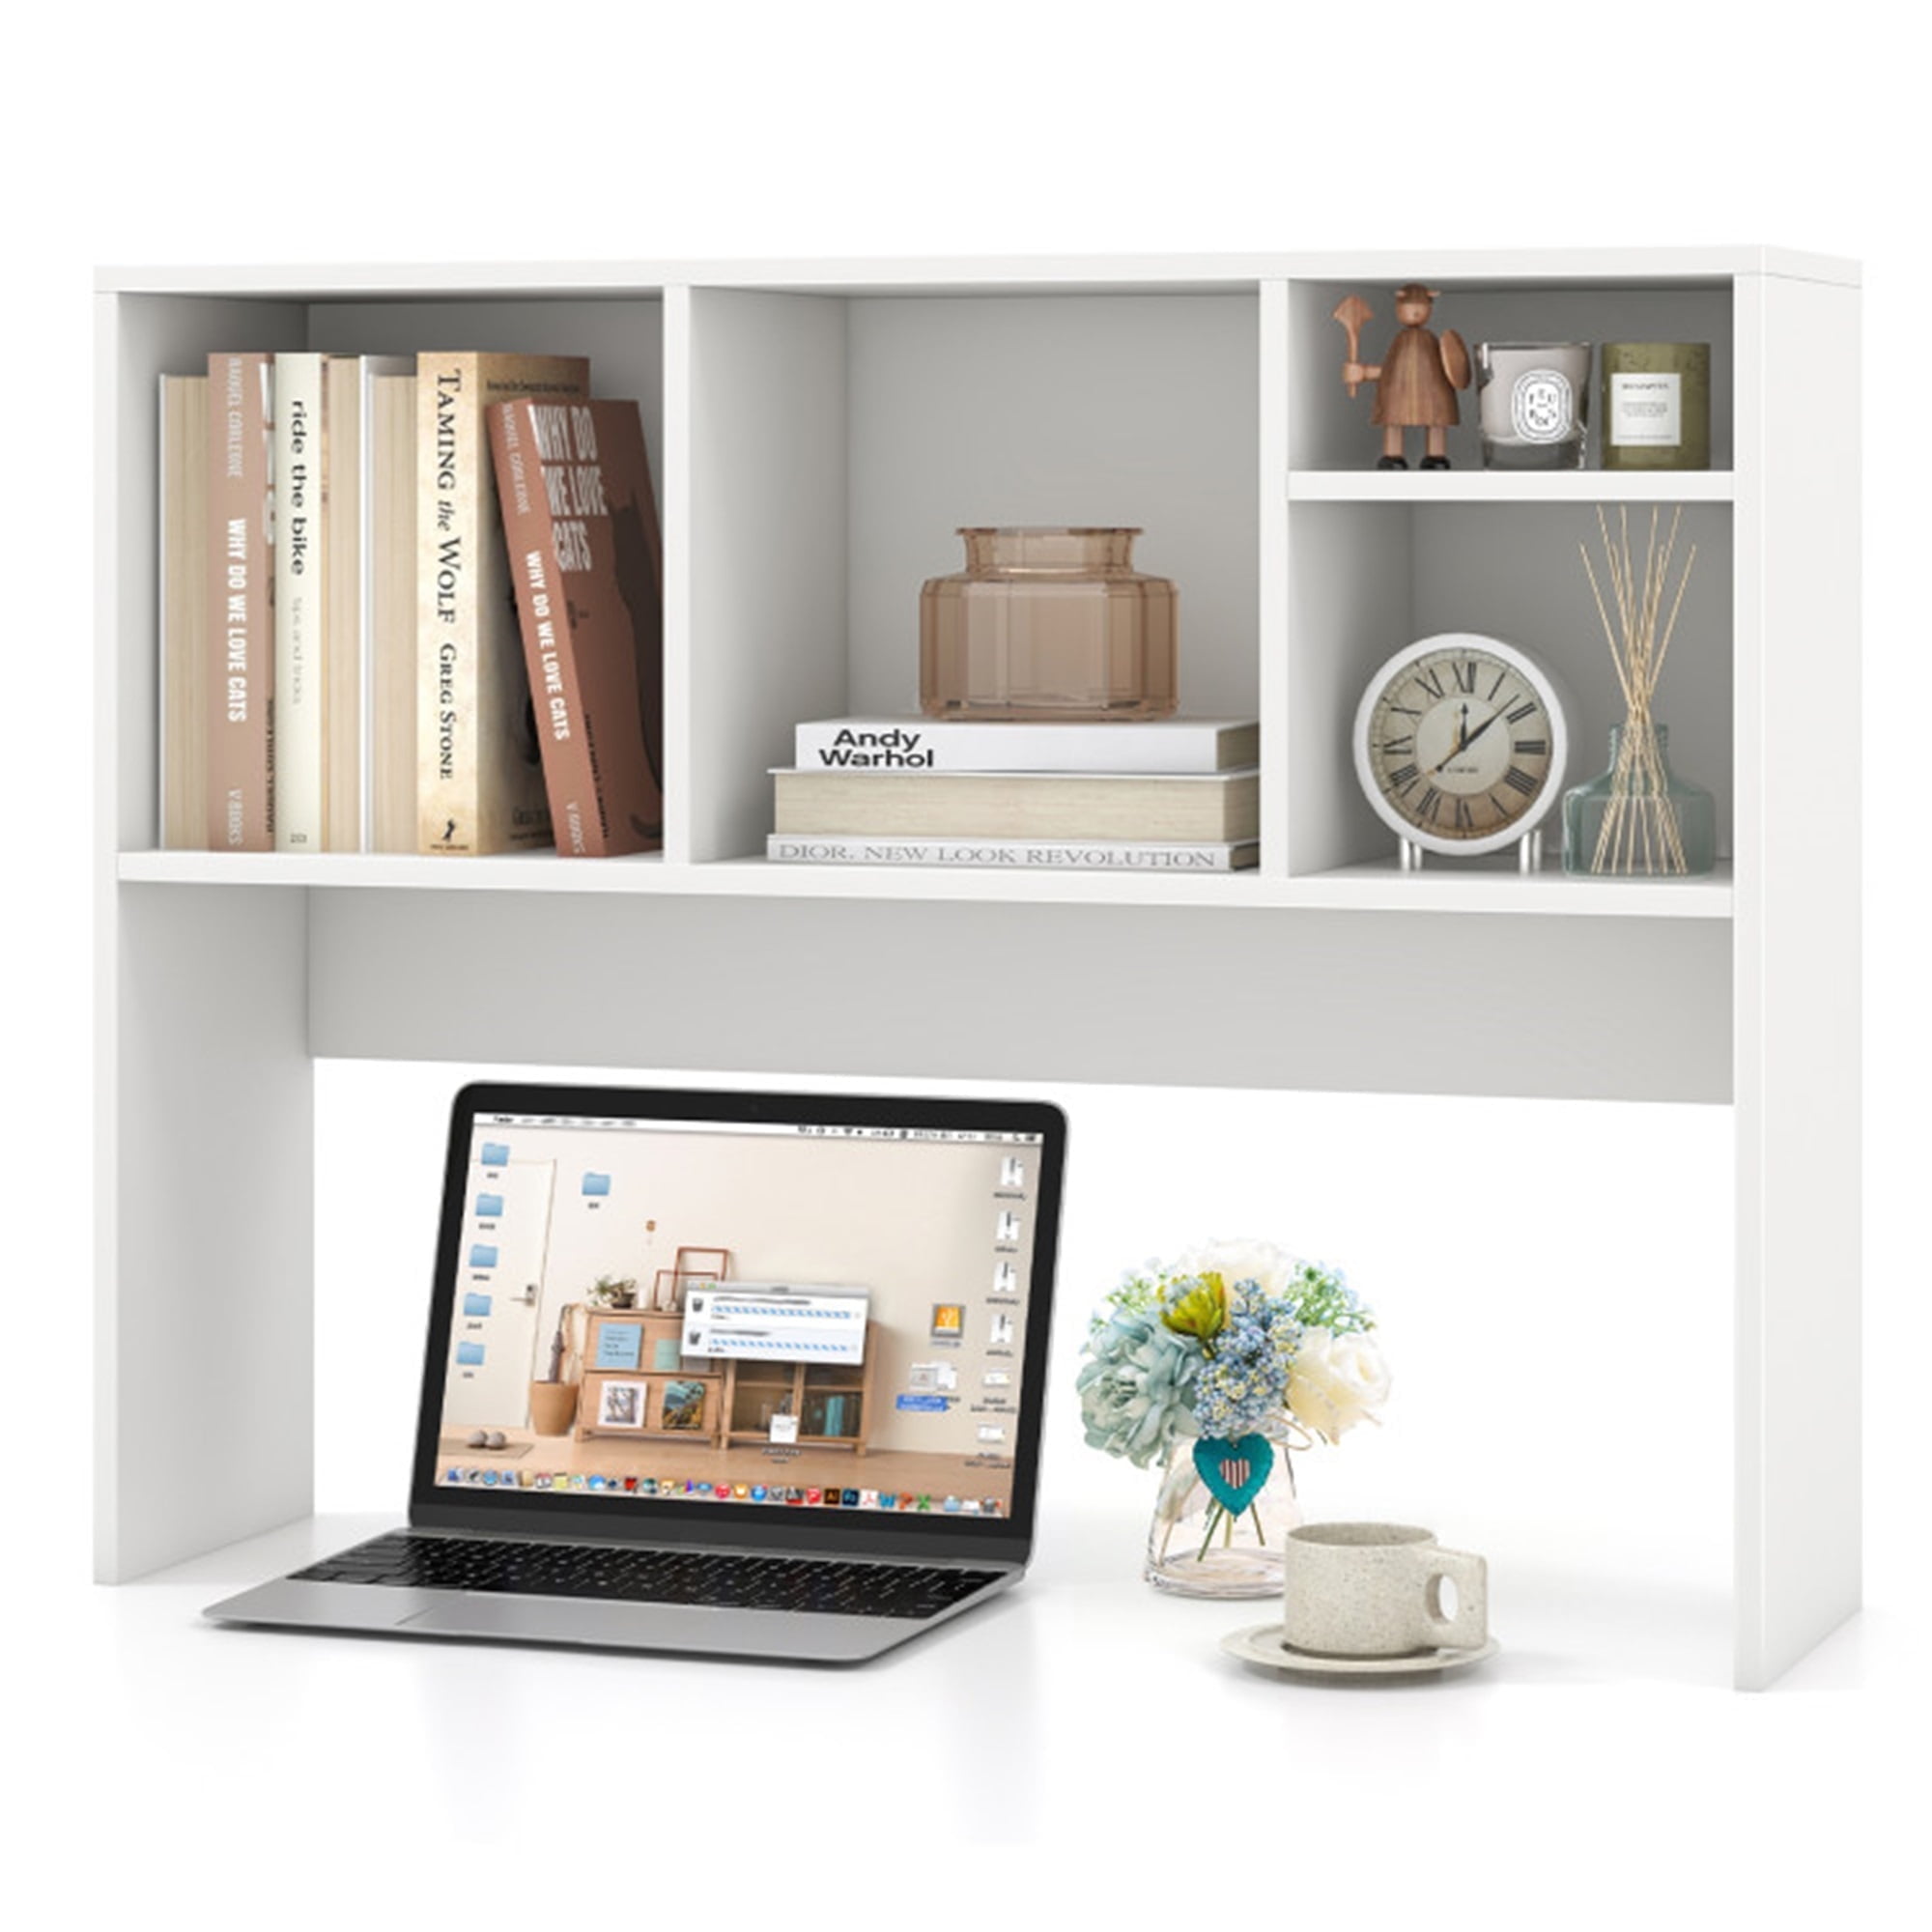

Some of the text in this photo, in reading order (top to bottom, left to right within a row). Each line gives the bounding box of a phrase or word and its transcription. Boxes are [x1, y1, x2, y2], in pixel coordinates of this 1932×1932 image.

[526, 404, 599, 462] WHY DO
[292, 400, 307, 576] ride the bike
[438, 368, 462, 624] TAMING the WOLF
[540, 465, 610, 517] WE LOVE
[553, 520, 593, 572] CATS
[228, 518, 247, 724] WHY DO WE LOVE CATS
[526, 550, 571, 741] WHY DO WE LOVE CATS
[440, 643, 457, 781] GREG STONE
[834, 728, 922, 753] Andy
[819, 749, 934, 768] Warhol
[779, 843, 1216, 867] DIOR. NEW LOOK REVOLUTION
